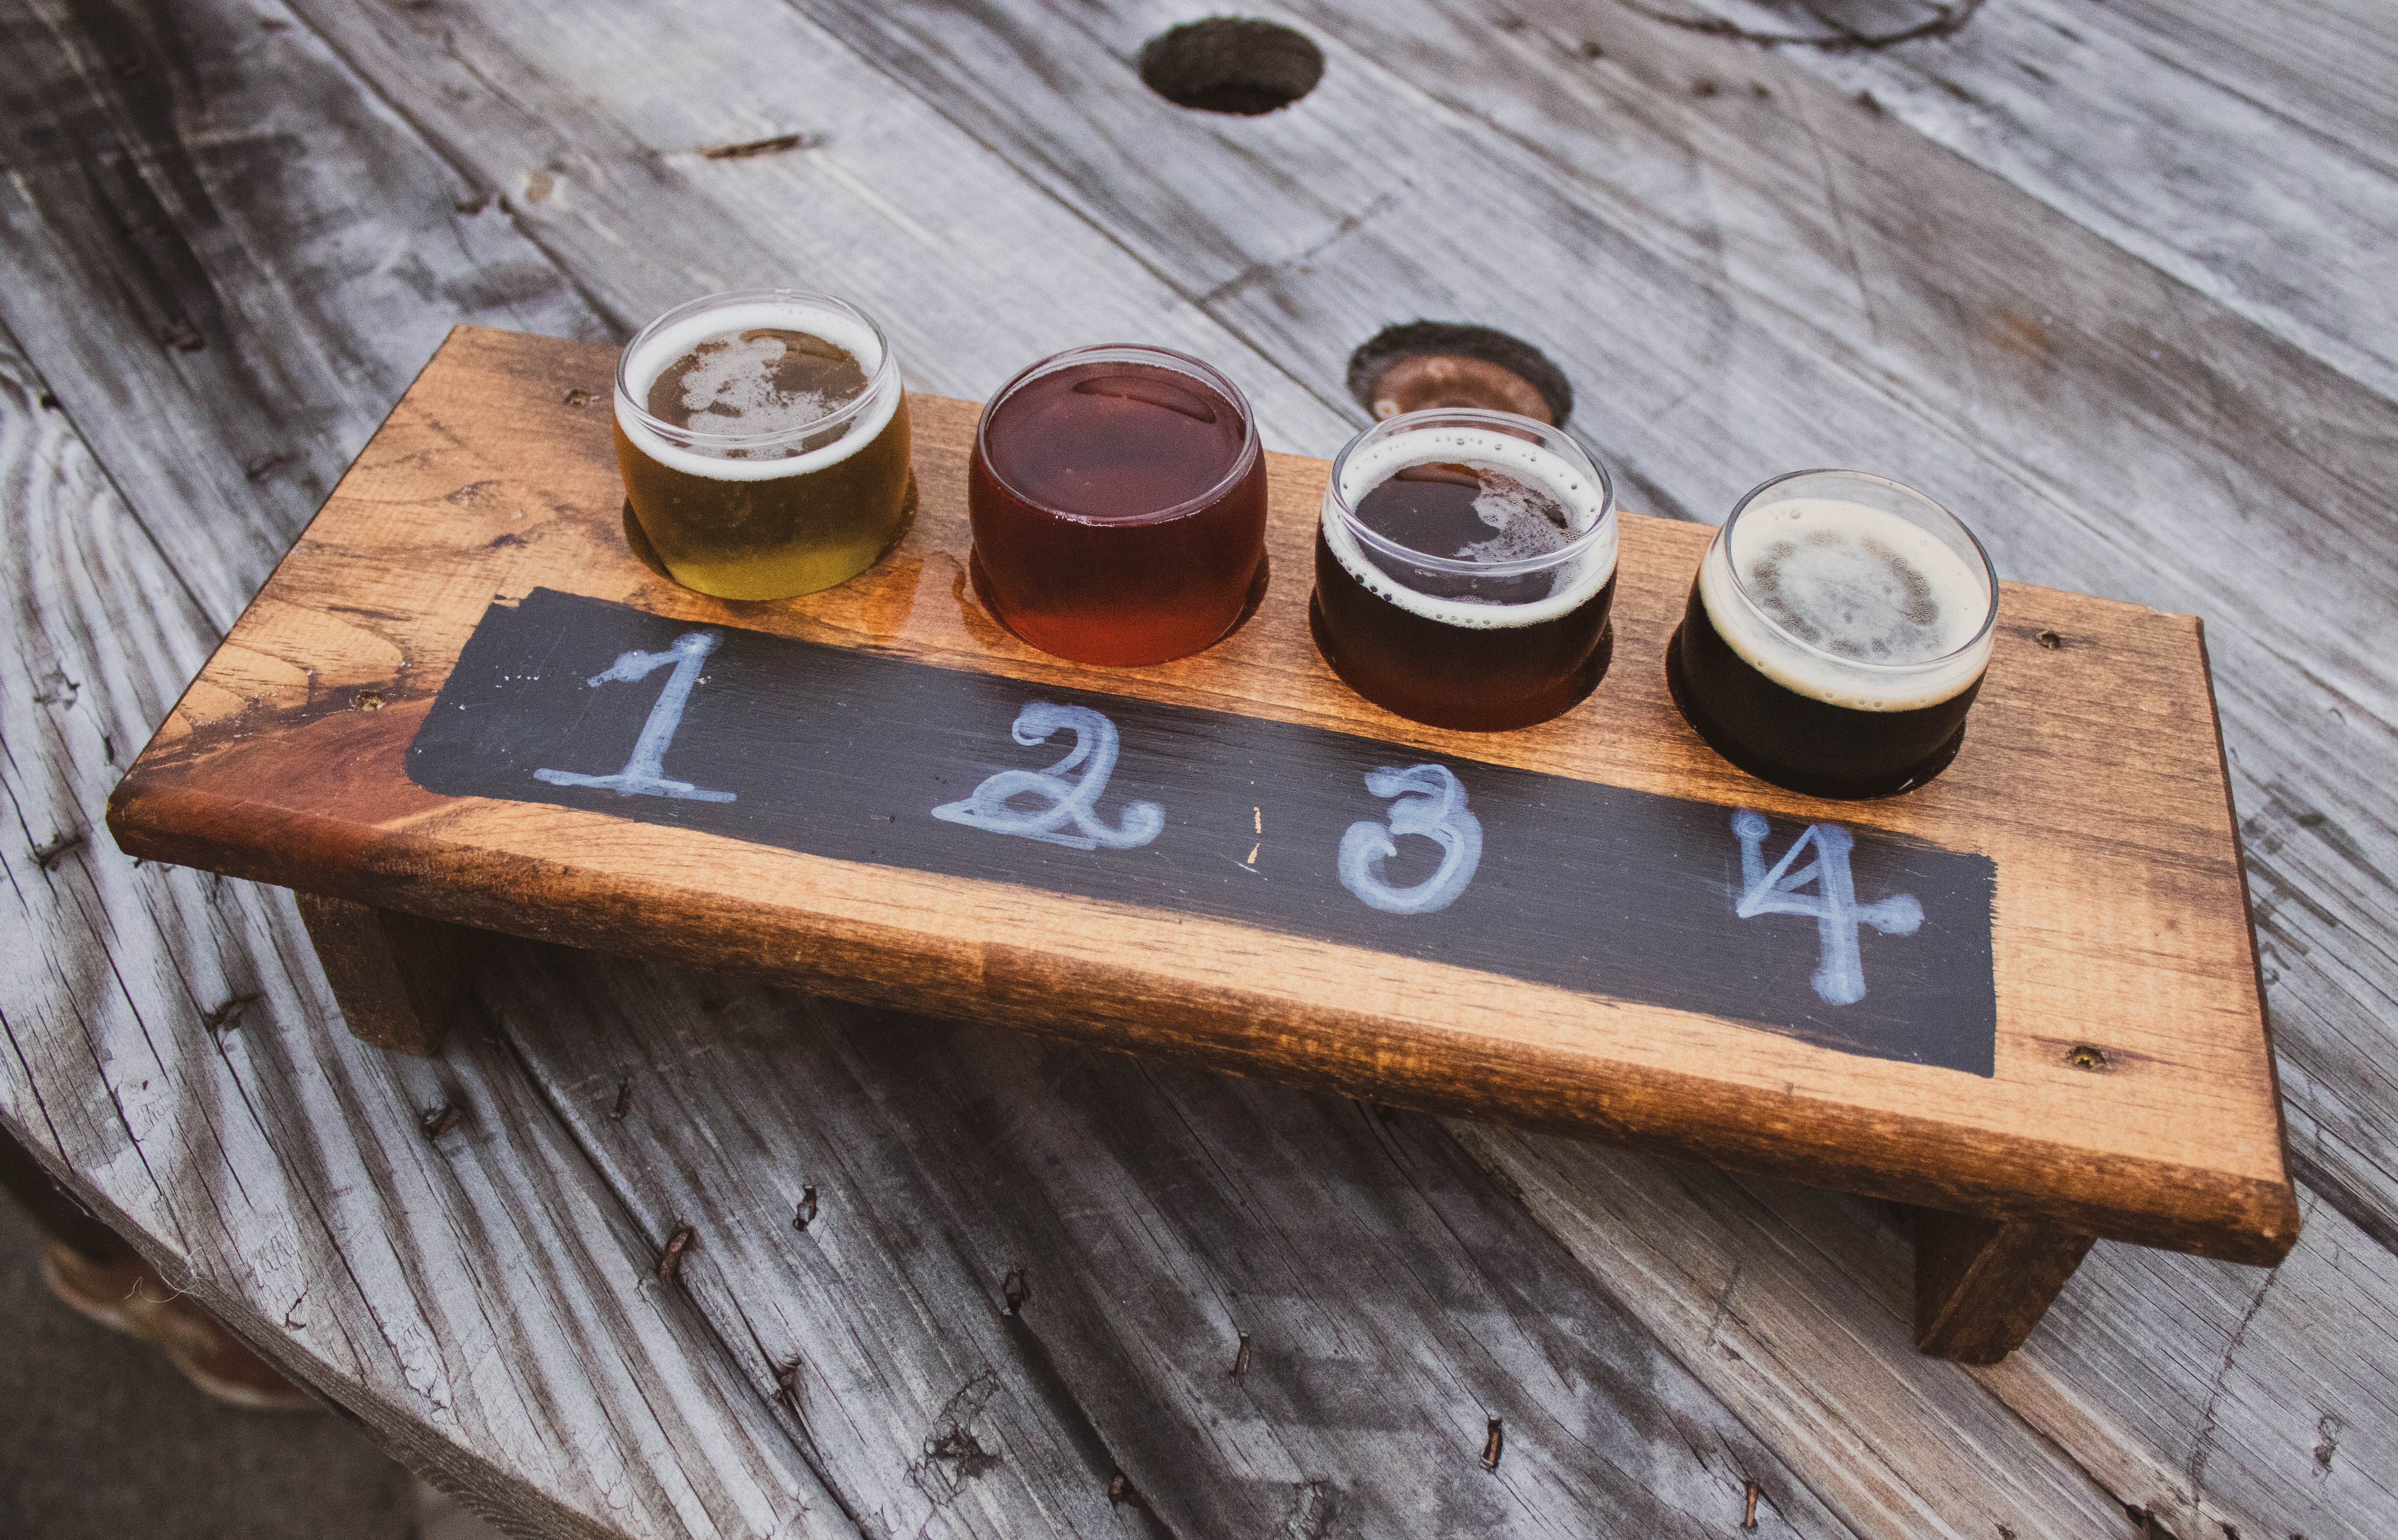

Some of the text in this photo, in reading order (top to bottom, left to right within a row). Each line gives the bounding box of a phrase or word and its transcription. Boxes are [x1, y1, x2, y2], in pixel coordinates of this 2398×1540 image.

[532, 629, 1927, 1006] 1 2 3 4
